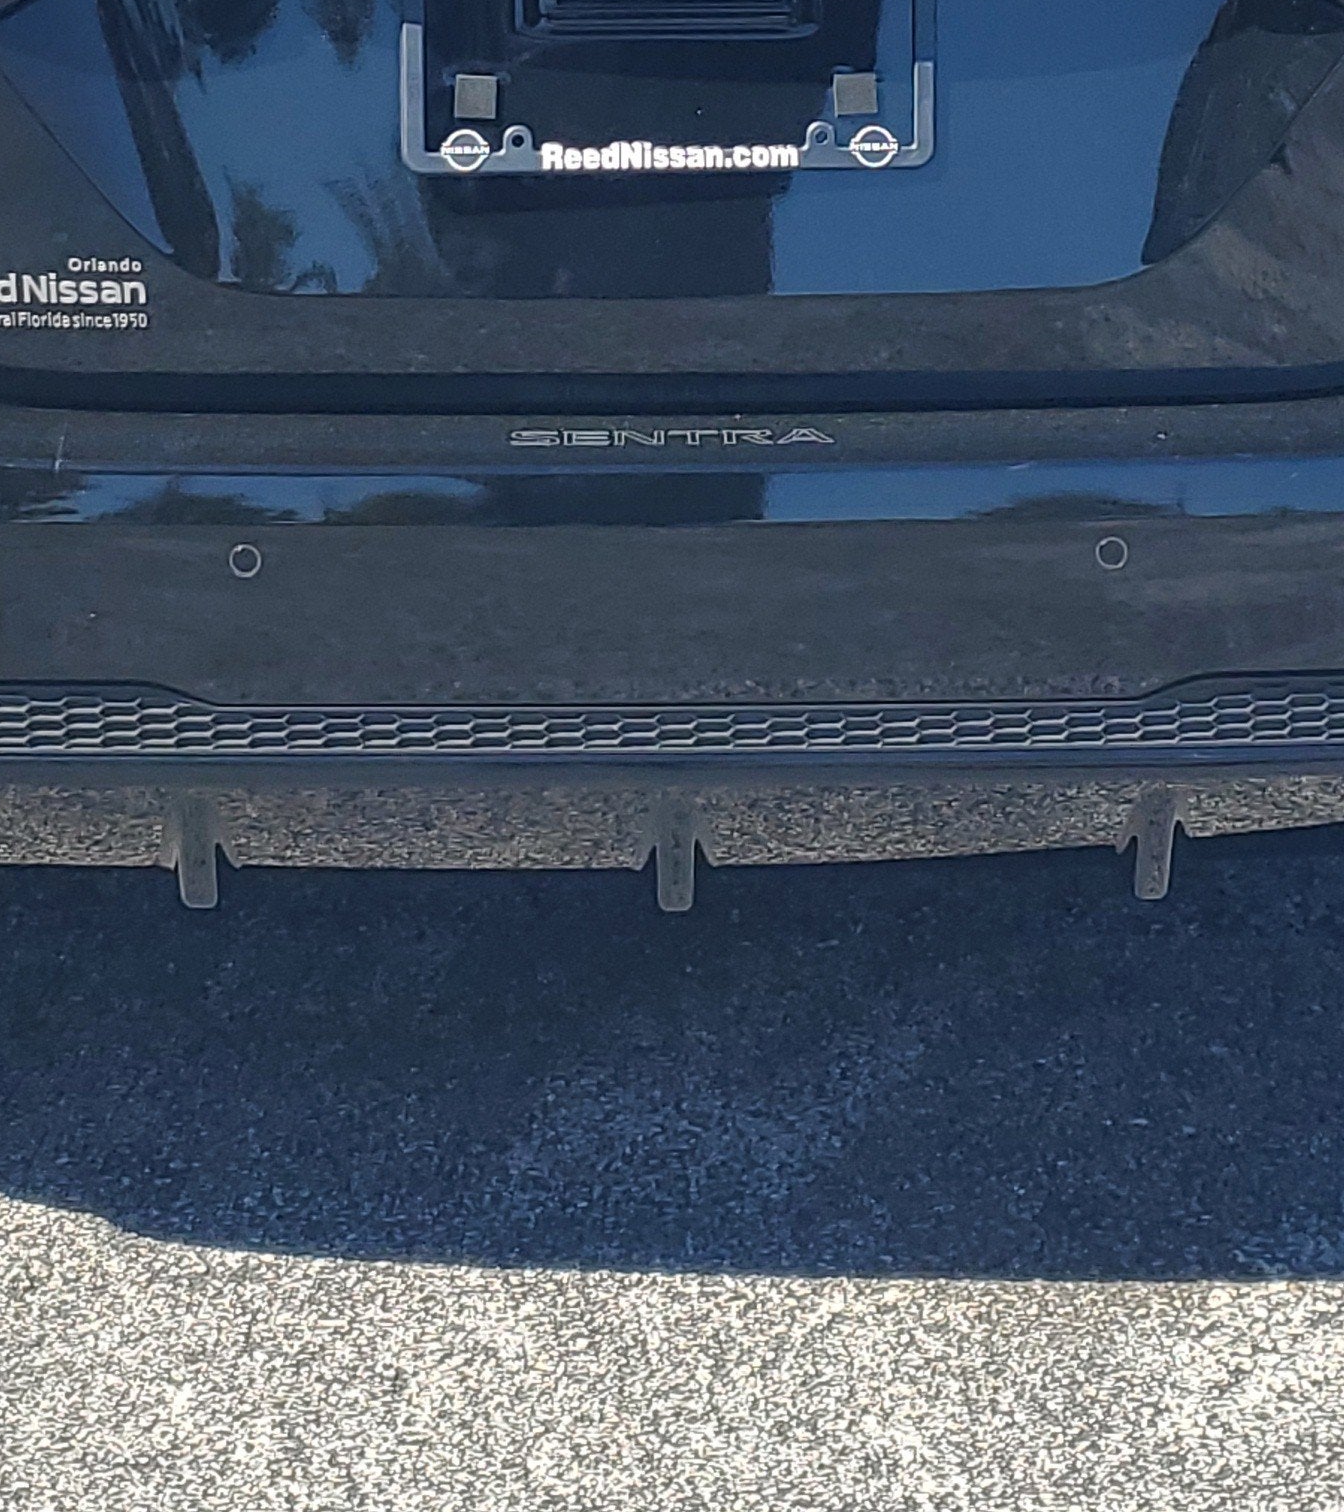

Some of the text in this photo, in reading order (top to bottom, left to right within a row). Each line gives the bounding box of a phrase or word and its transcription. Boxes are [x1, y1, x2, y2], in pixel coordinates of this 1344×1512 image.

[441, 145, 490, 155] NISSAN
[849, 141, 899, 152] NISSAN
[541, 140, 799, 171] ReedNissan.com
[68, 257, 142, 273] Orlando
[22, 272, 147, 305] Nissan
[18, 311, 71, 328] Florida
[72, 311, 113, 328] since
[113, 312, 148, 328] 1950
[509, 427, 836, 447] SENTRA
